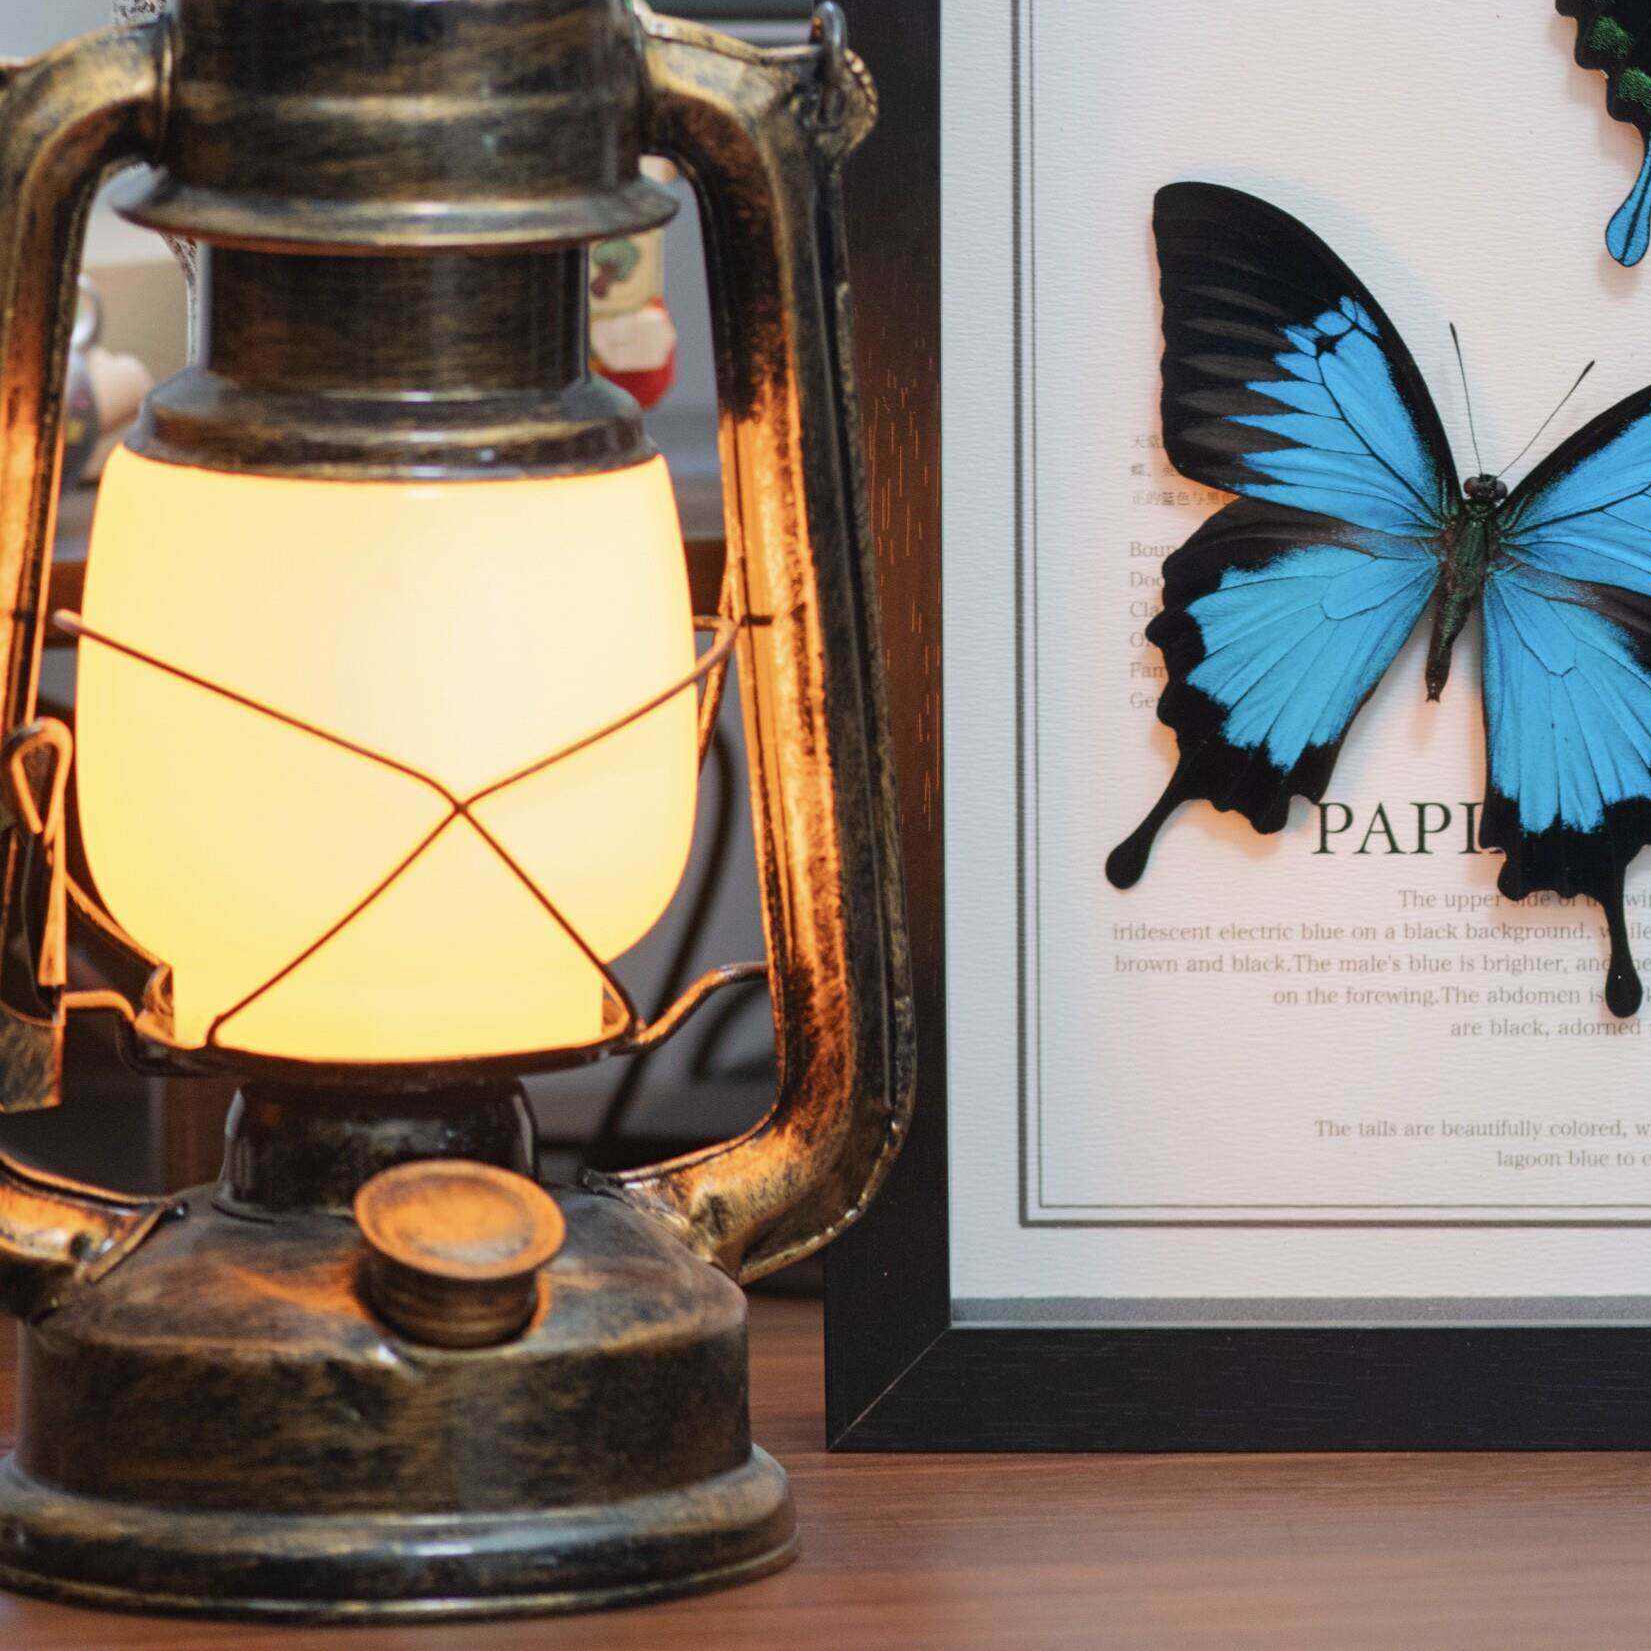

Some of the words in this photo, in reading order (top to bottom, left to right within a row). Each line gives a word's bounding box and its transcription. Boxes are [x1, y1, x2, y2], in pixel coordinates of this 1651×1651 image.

[1312, 801, 1484, 854] PAPI
[1398, 890, 1436, 907] The
[1112, 923, 1211, 940] iridescent
[1219, 923, 1293, 940] electric
[1301, 923, 1344, 940] blue
[1351, 928, 1377, 940] on
[1385, 928, 1396, 940] a
[1404, 923, 1458, 940] black
[1465, 923, 1591, 945] background,
[1115, 954, 1178, 971] brown
[1186, 954, 1223, 971] and
[1339, 954, 1401, 971] male's
[1408, 954, 1452, 971] blue
[1460, 954, 1474, 971] is
[1483, 954, 1568, 976] brighter,
[1273, 992, 1298, 1004] on
[1307, 987, 1338, 1004] the
[1487, 987, 1580, 1004] abdomen
[1589, 987, 1604, 1004] is
[1451, 1023, 1482, 1036] are
[1490, 1018, 1550, 1038] black,
[1558, 1018, 1641, 1036] adorned
[1314, 1119, 1351, 1136] The
[1359, 1119, 1397, 1136] tails
[1404, 1124, 1434, 1136] are
[1442, 1119, 1541, 1141] beautifully
[1549, 1119, 1627, 1138] colored,
[1497, 1149, 1561, 1171] lagoon
[1568, 1149, 1609, 1166] blue
[1616, 1149, 1636, 1166] to
